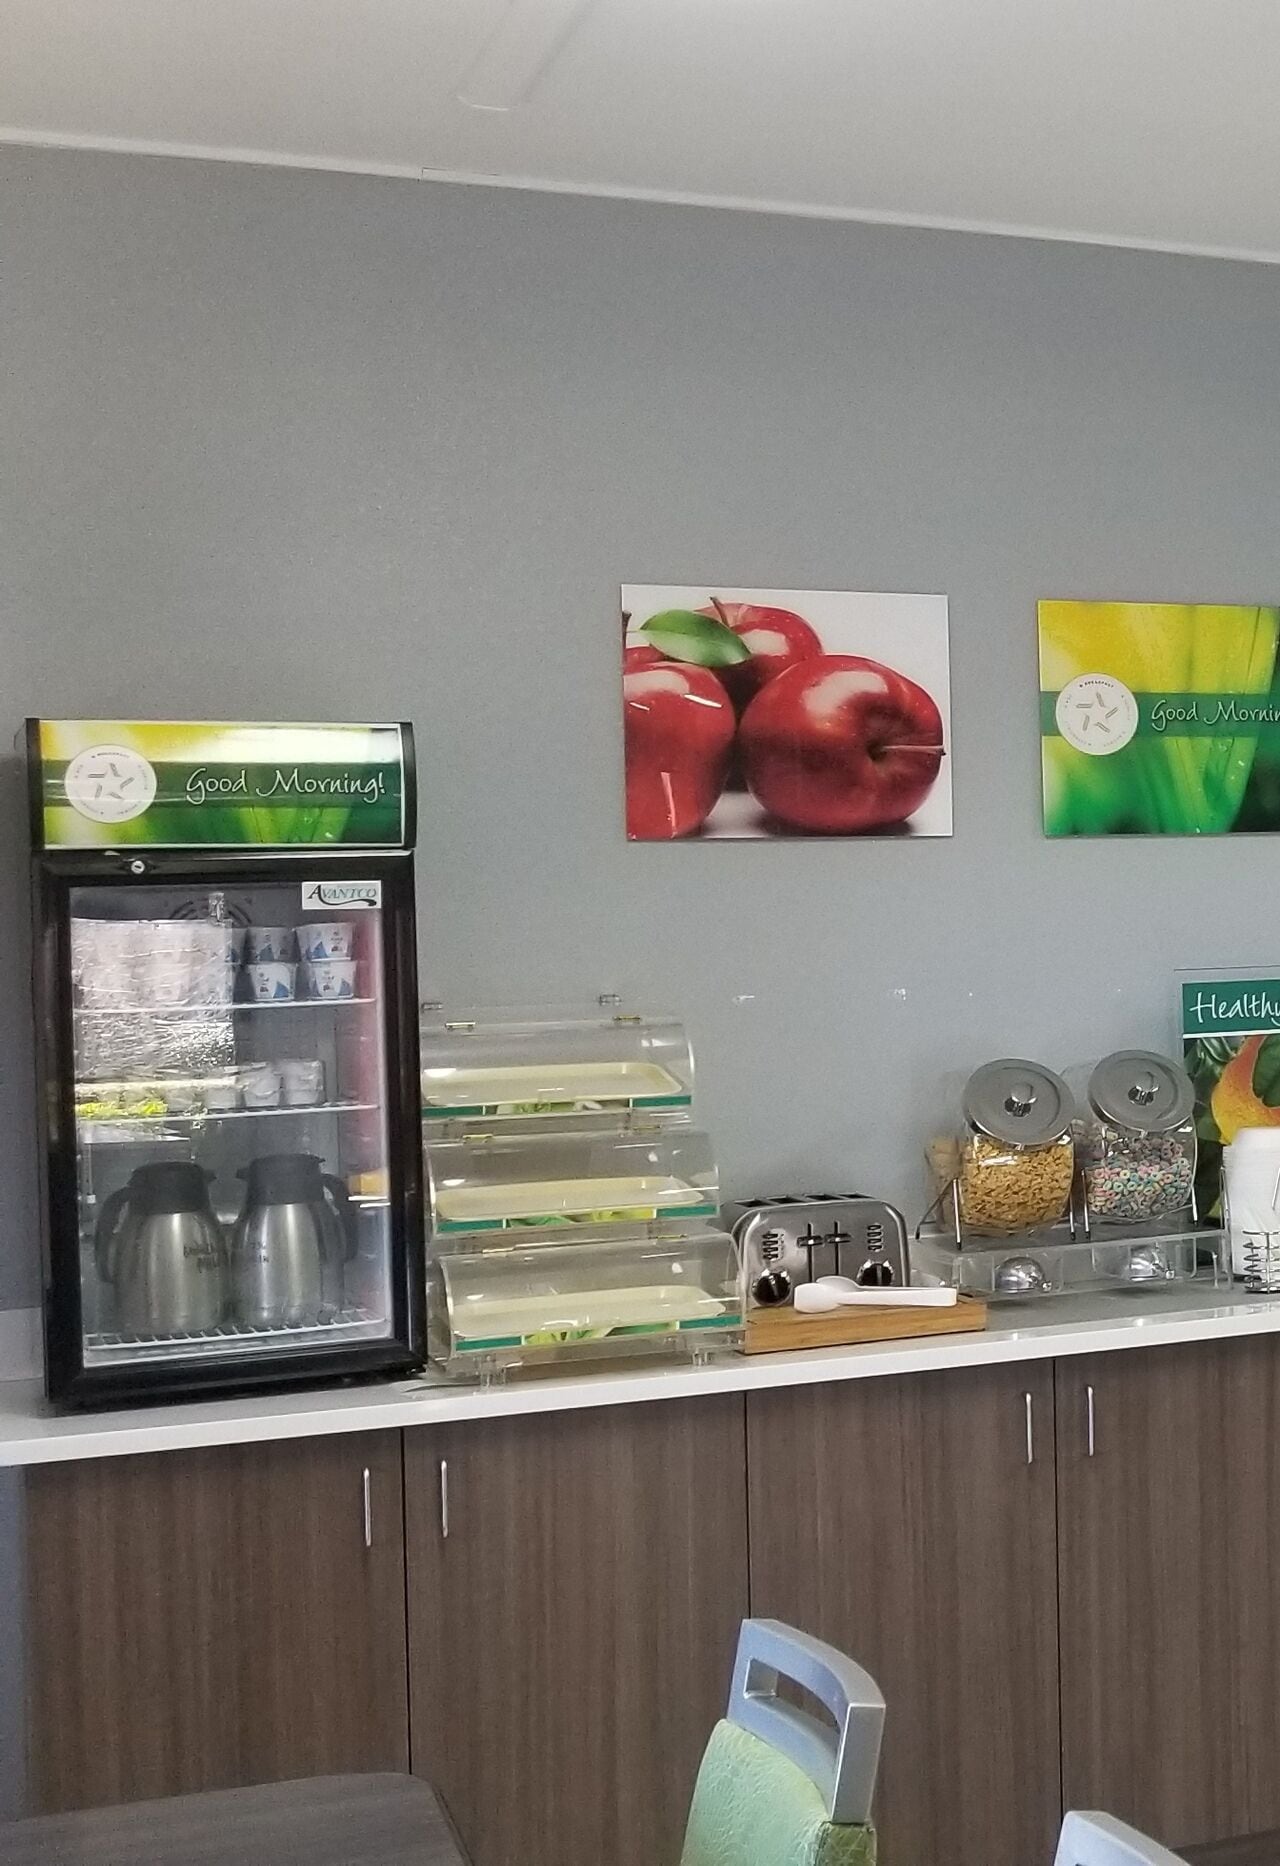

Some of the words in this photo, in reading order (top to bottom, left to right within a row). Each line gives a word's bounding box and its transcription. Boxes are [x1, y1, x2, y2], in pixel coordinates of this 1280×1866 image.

[1151, 699, 1199, 732] Good
[186, 767, 248, 805] Good
[255, 767, 386, 804] Morning!
